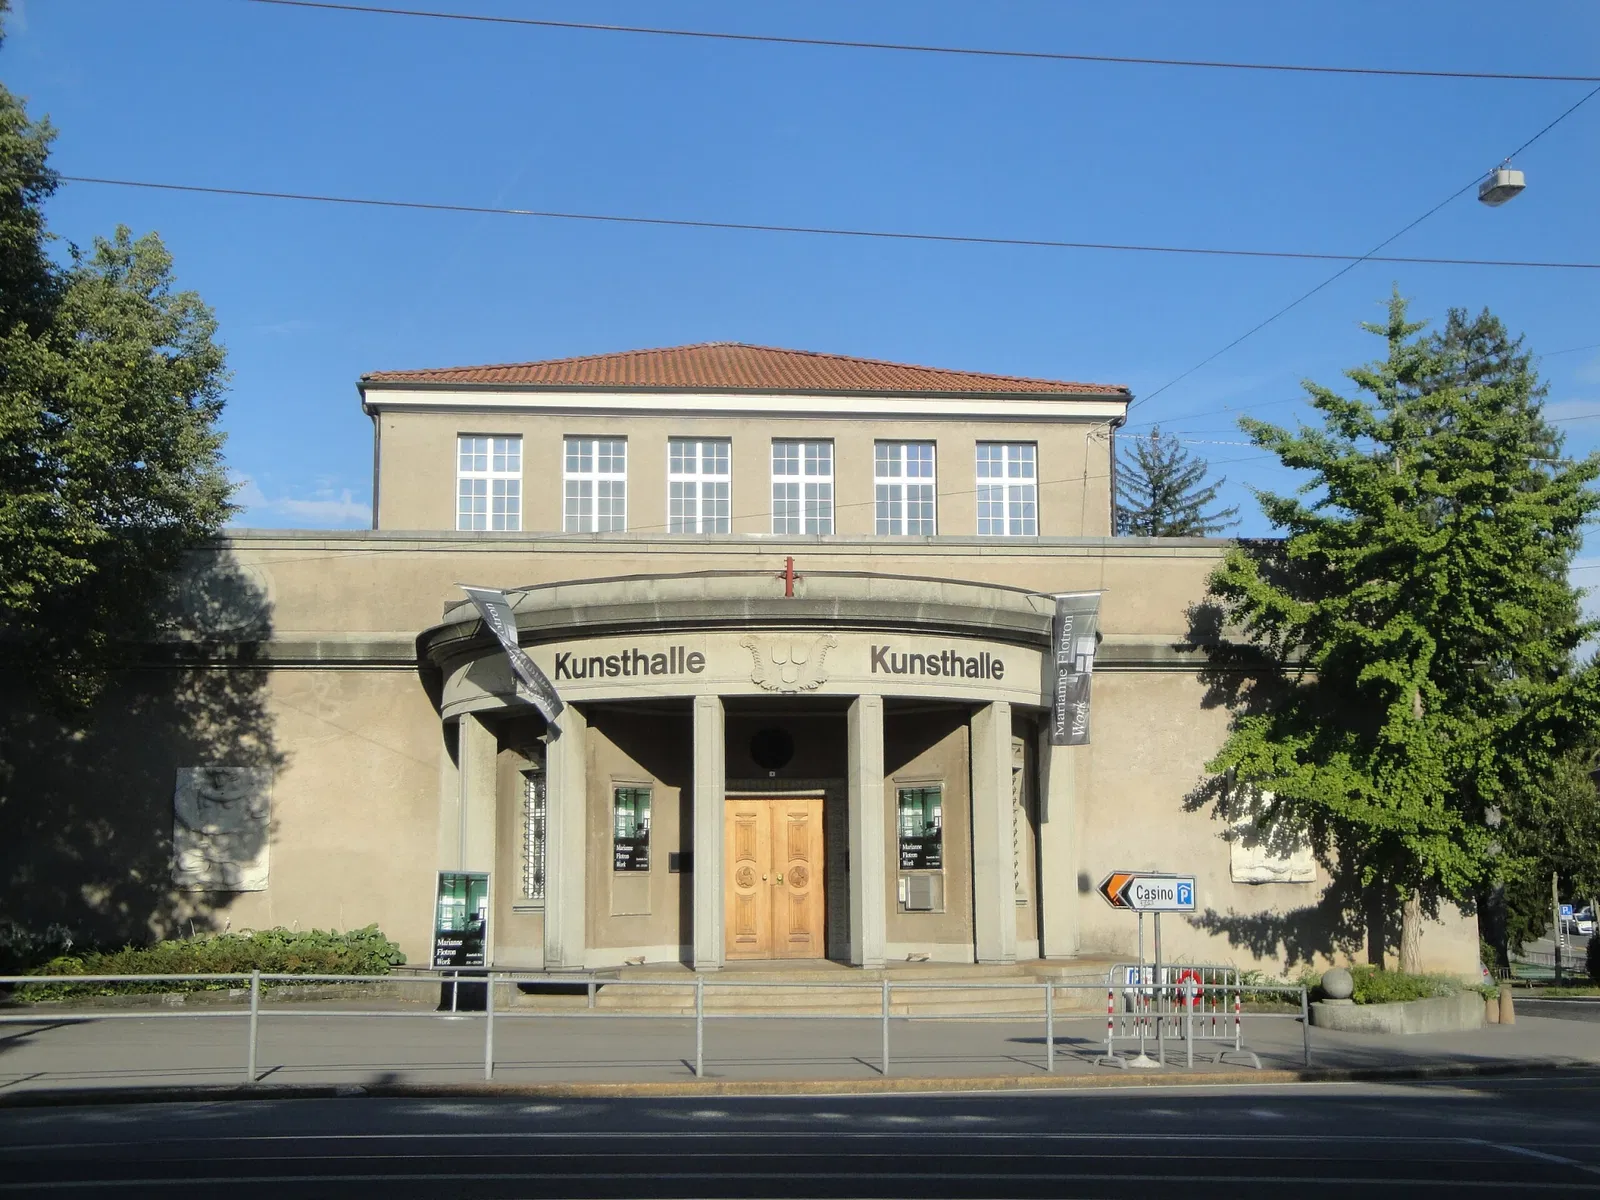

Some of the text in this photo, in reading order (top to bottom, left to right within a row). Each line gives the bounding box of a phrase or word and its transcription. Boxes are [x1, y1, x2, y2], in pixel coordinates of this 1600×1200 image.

[555, 646, 706, 680] Kunsthalle
[871, 645, 1005, 680] Kunsthalle
[1055, 615, 1074, 737] Marianne Flotron
[1071, 699, 1087, 737] Work
[1136, 884, 1174, 900] Casino
[437, 938, 463, 946] Marianne
[437, 957, 451, 965] Work
